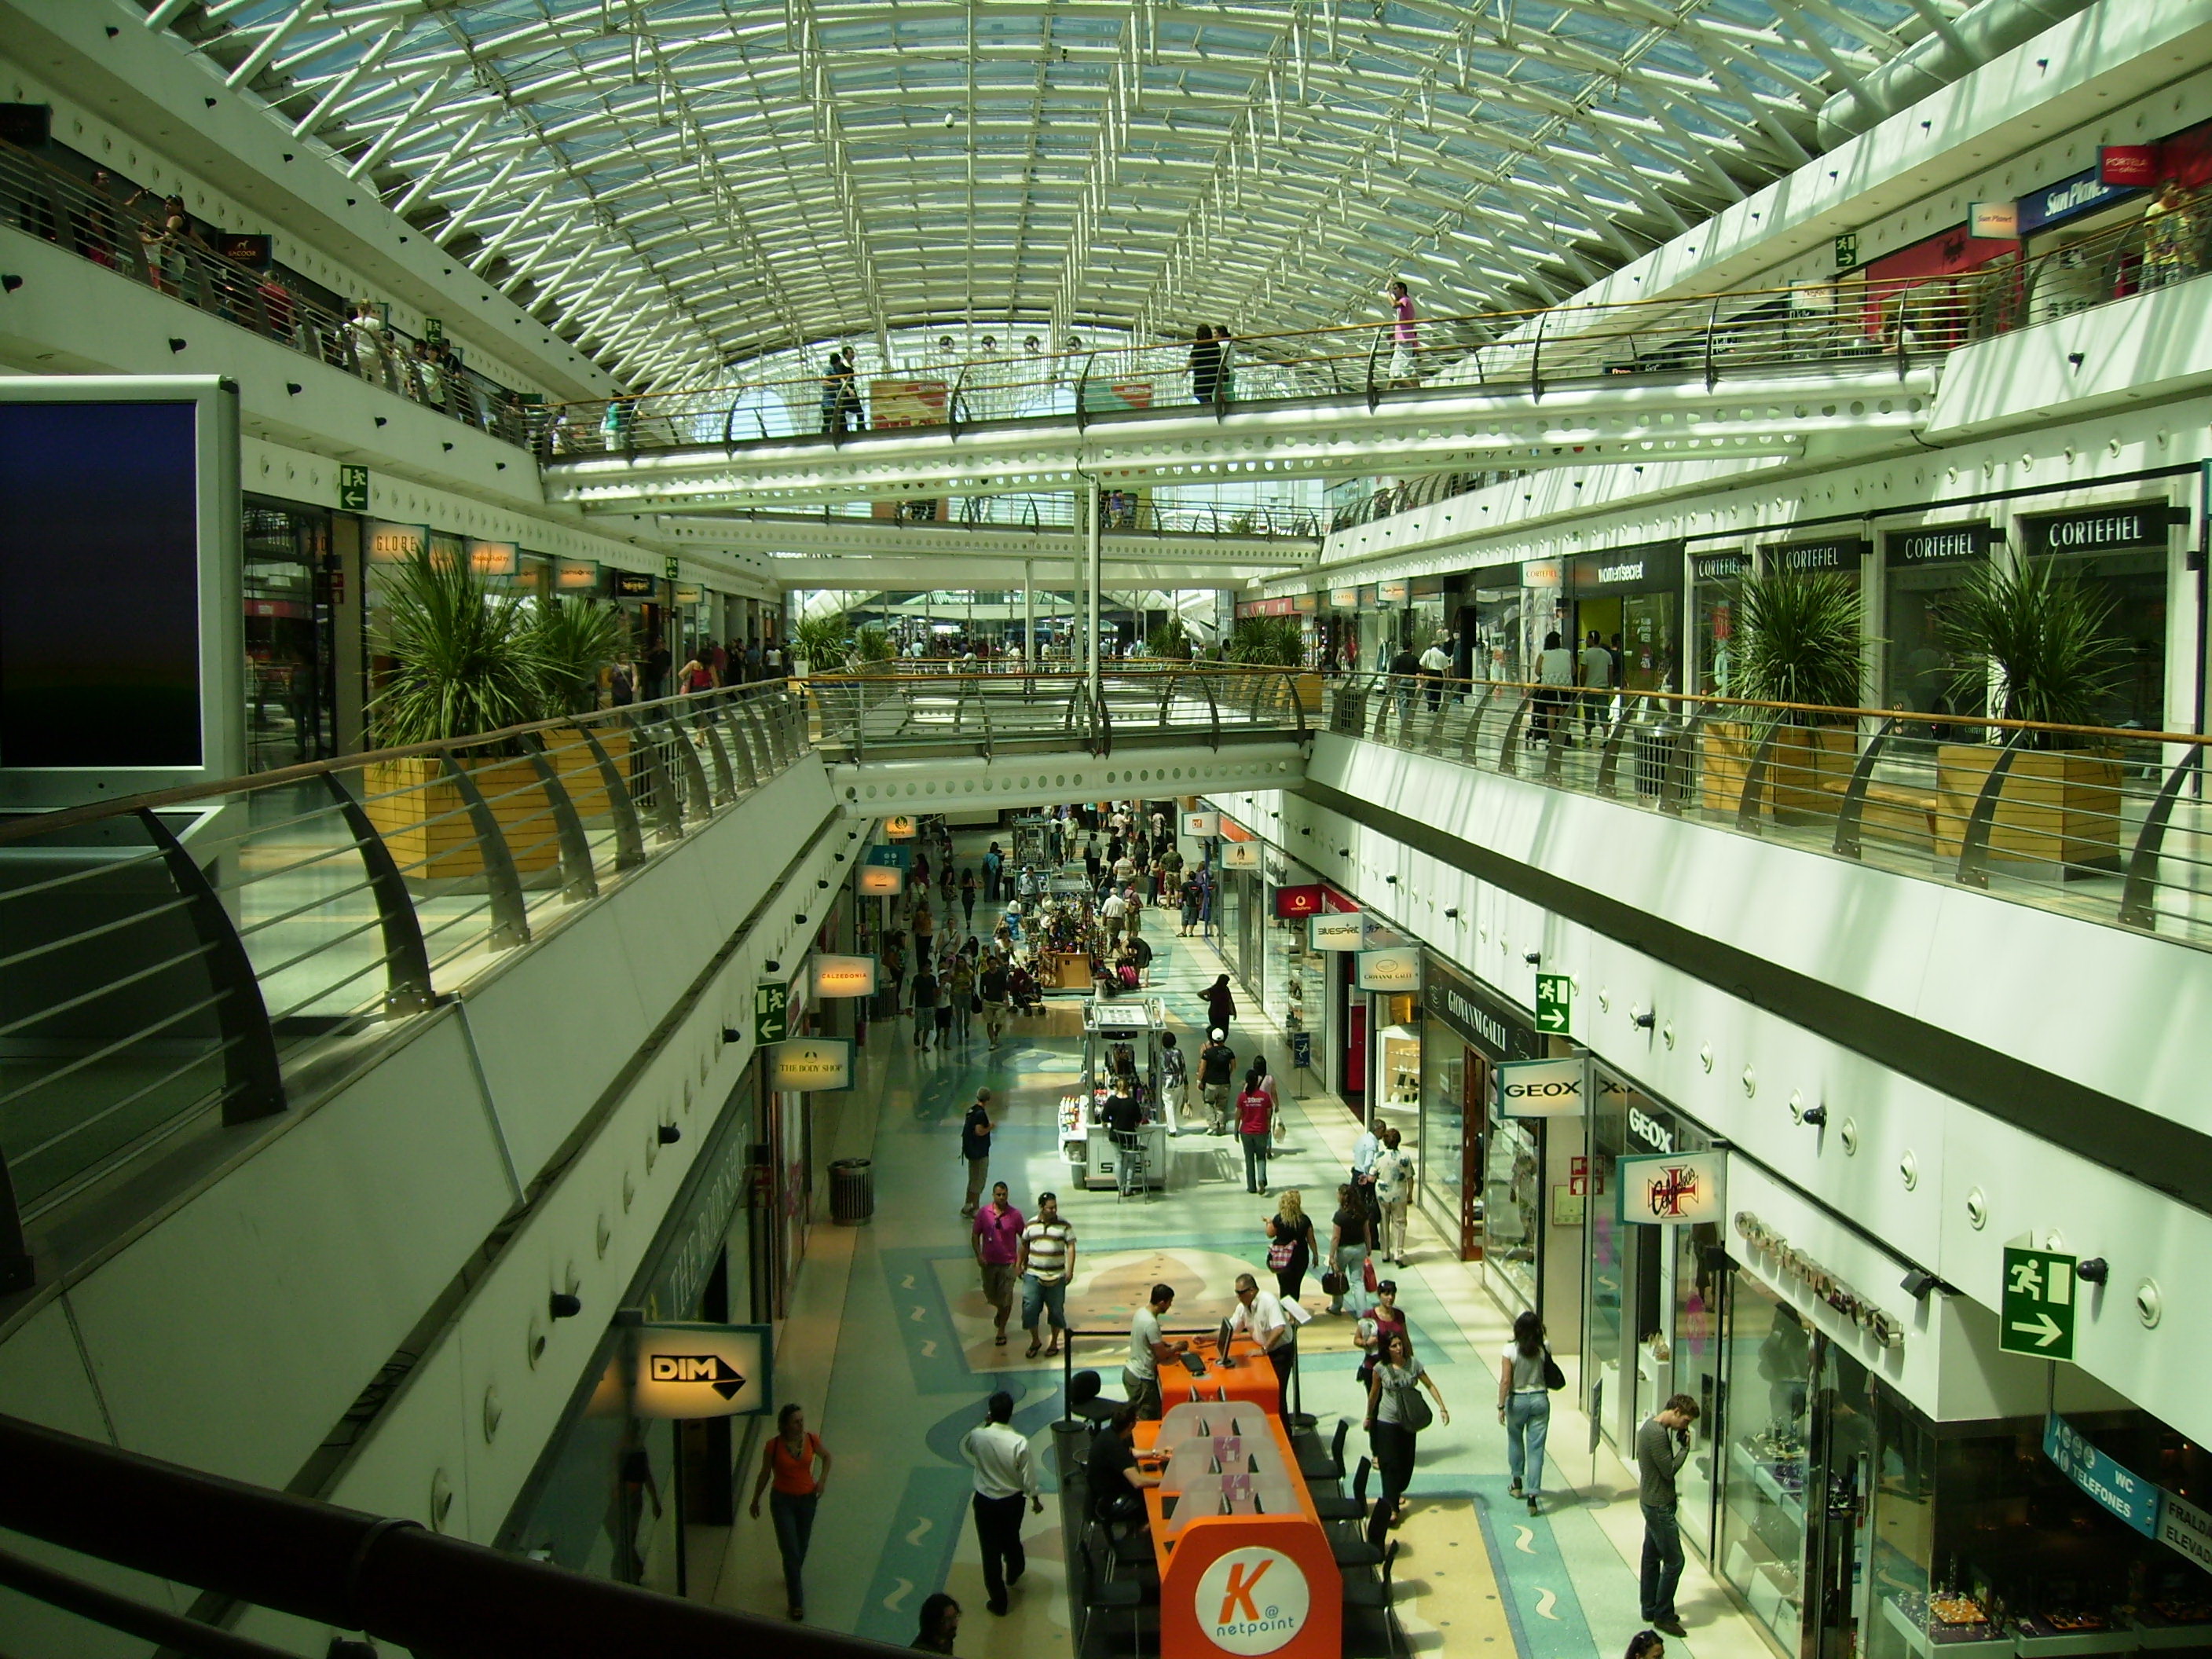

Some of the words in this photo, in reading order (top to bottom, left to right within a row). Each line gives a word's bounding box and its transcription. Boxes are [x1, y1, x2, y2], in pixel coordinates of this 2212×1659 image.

[2045, 191, 2069, 217] Sun
[1992, 214, 2012, 223] Planet
[2049, 515, 2143, 547] CORTEFIEL
[376, 536, 416, 551] GLOBE
[1905, 533, 1974, 559] CORTEFIEL
[1785, 547, 1839, 569] CORTEFIEL
[1525, 568, 1558, 579] CORTEFIEL
[1598, 561, 1644, 583] women'secret
[1448, 989, 1482, 1034] GIOVANNI
[1482, 1014, 1507, 1053] GALLI
[780, 1064, 797, 1072] THE
[799, 1064, 819, 1072] BODY
[822, 1064, 843, 1072] SHOP
[1504, 1079, 1582, 1098] GEOX
[1629, 1107, 1674, 1154] GEOX
[653, 1357, 717, 1380] DIM
[2072, 1463, 2132, 1518] TELEFONES
[2115, 1470, 2134, 1494] WC
[2166, 1525, 2212, 1565] ELEVAD
[1218, 1558, 1274, 1625] K
[1216, 1617, 1295, 1637] netpoint
